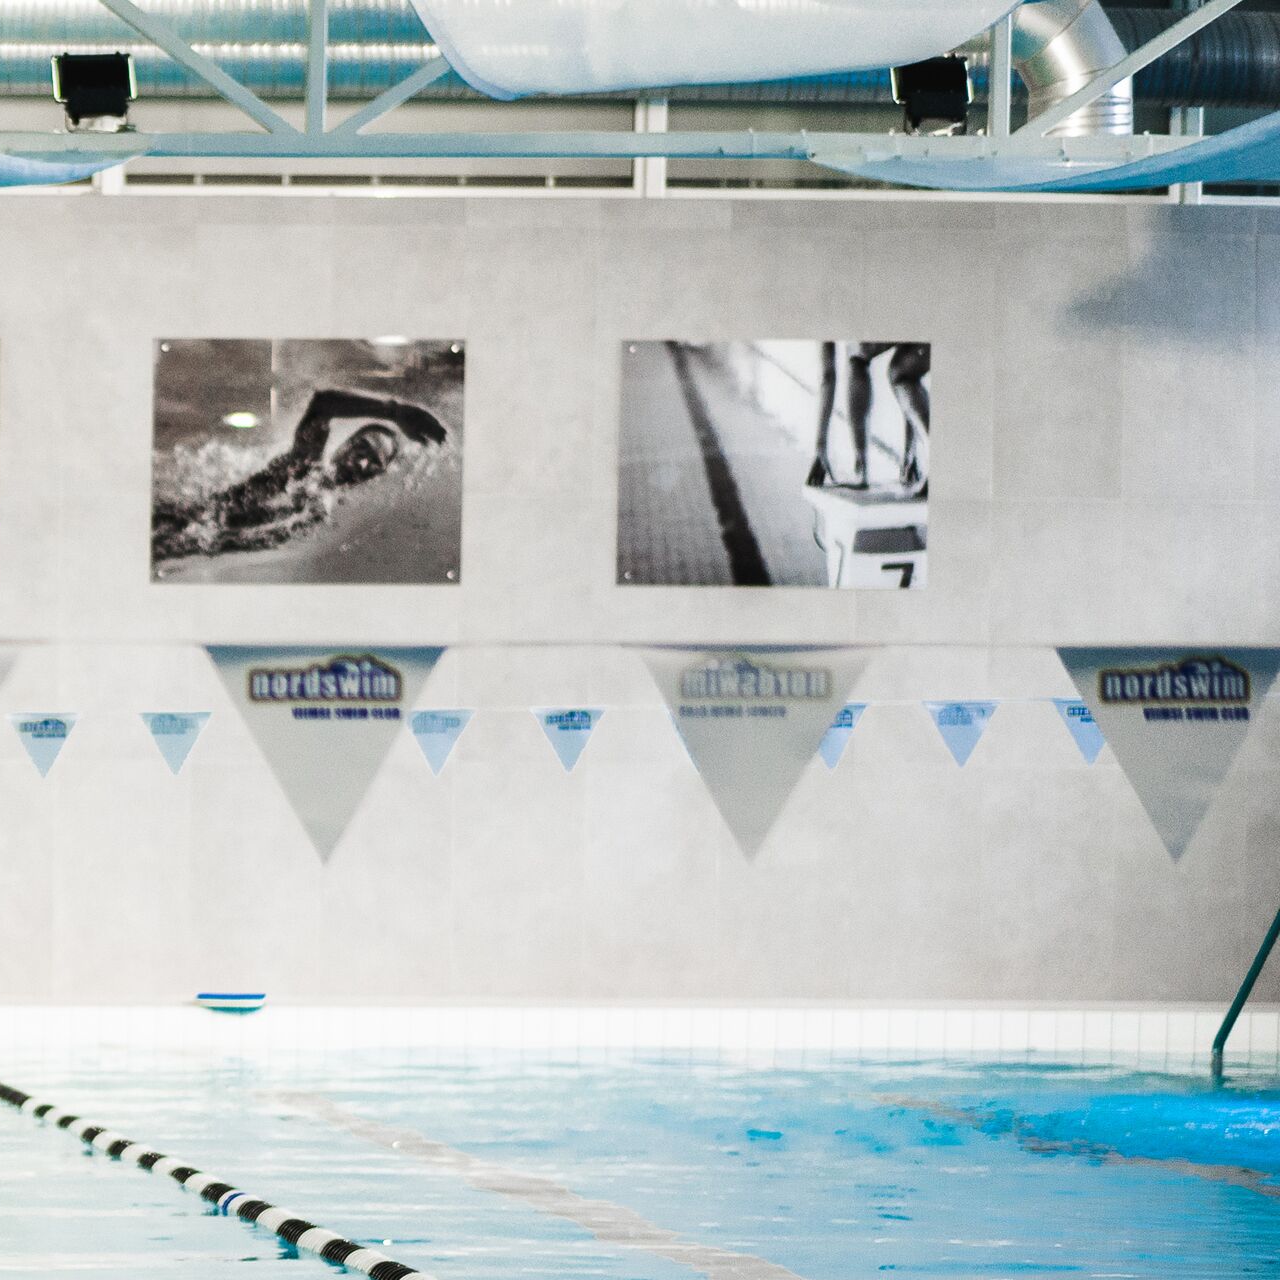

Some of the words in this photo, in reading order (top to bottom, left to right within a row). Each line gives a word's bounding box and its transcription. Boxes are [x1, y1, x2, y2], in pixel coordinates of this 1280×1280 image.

[881, 562, 914, 588] 7
[252, 660, 398, 698] nordswim
[1104, 660, 1248, 700] nordswim
